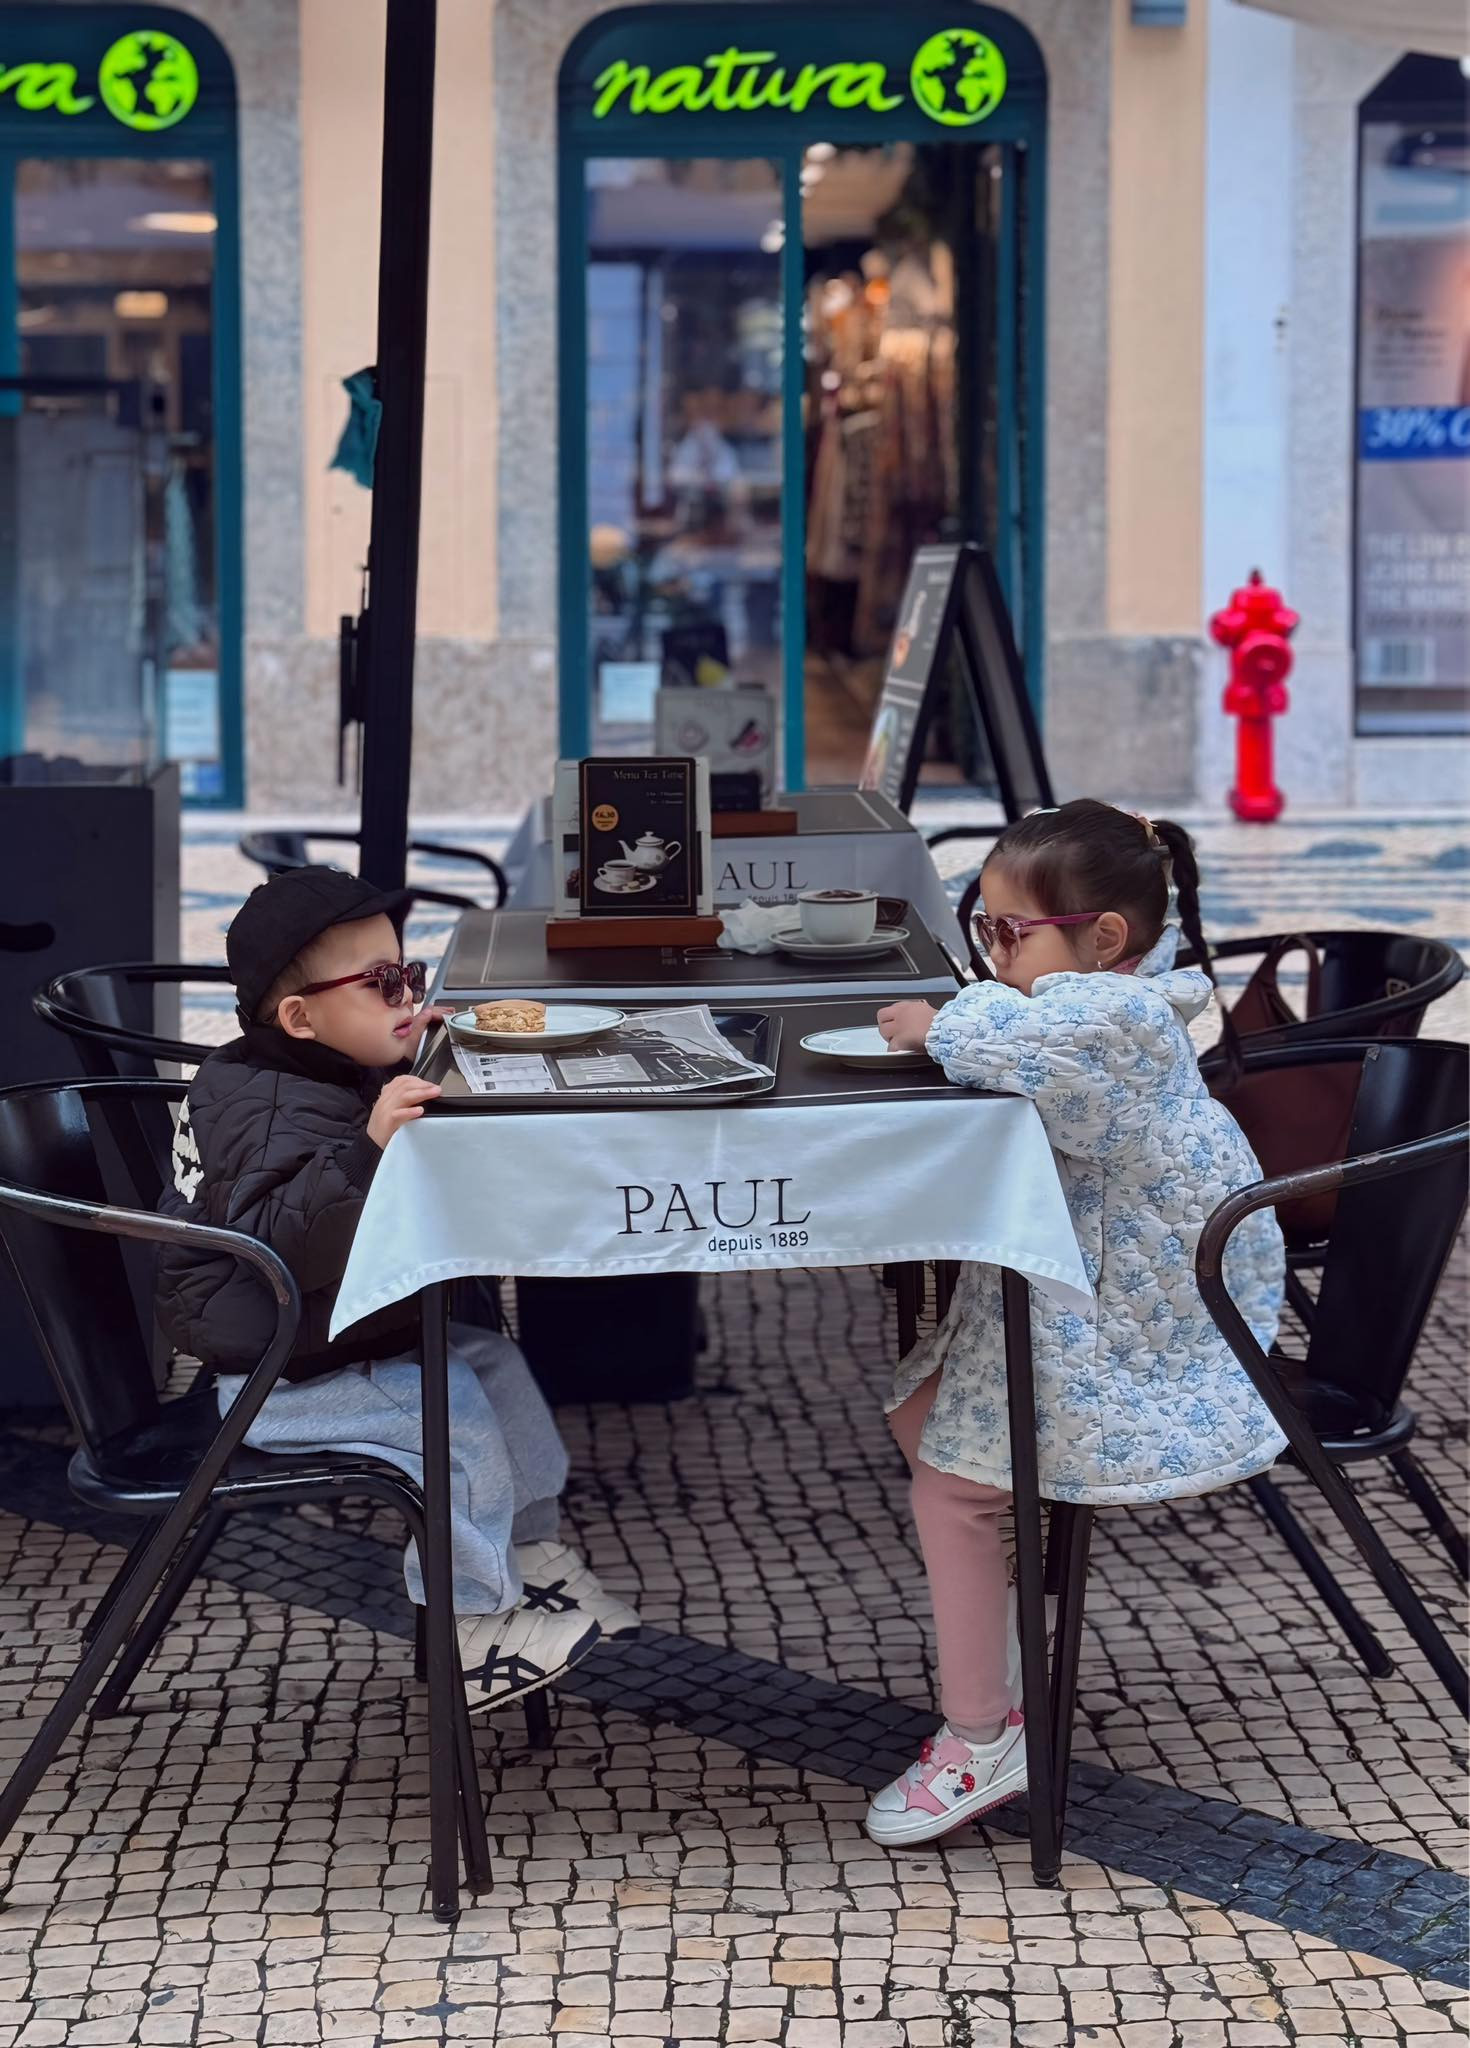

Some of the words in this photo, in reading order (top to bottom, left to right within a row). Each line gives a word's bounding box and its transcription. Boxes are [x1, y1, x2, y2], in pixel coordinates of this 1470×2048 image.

[592, 46, 905, 119] natura
[613, 769, 640, 780] Menu
[643, 769, 658, 780] Tea
[661, 769, 684, 780] Time
[716, 861, 809, 890] AUL
[615, 1178, 811, 1235] PAUL
[707, 1235, 763, 1255] depuis
[769, 1230, 809, 1249] 1889
